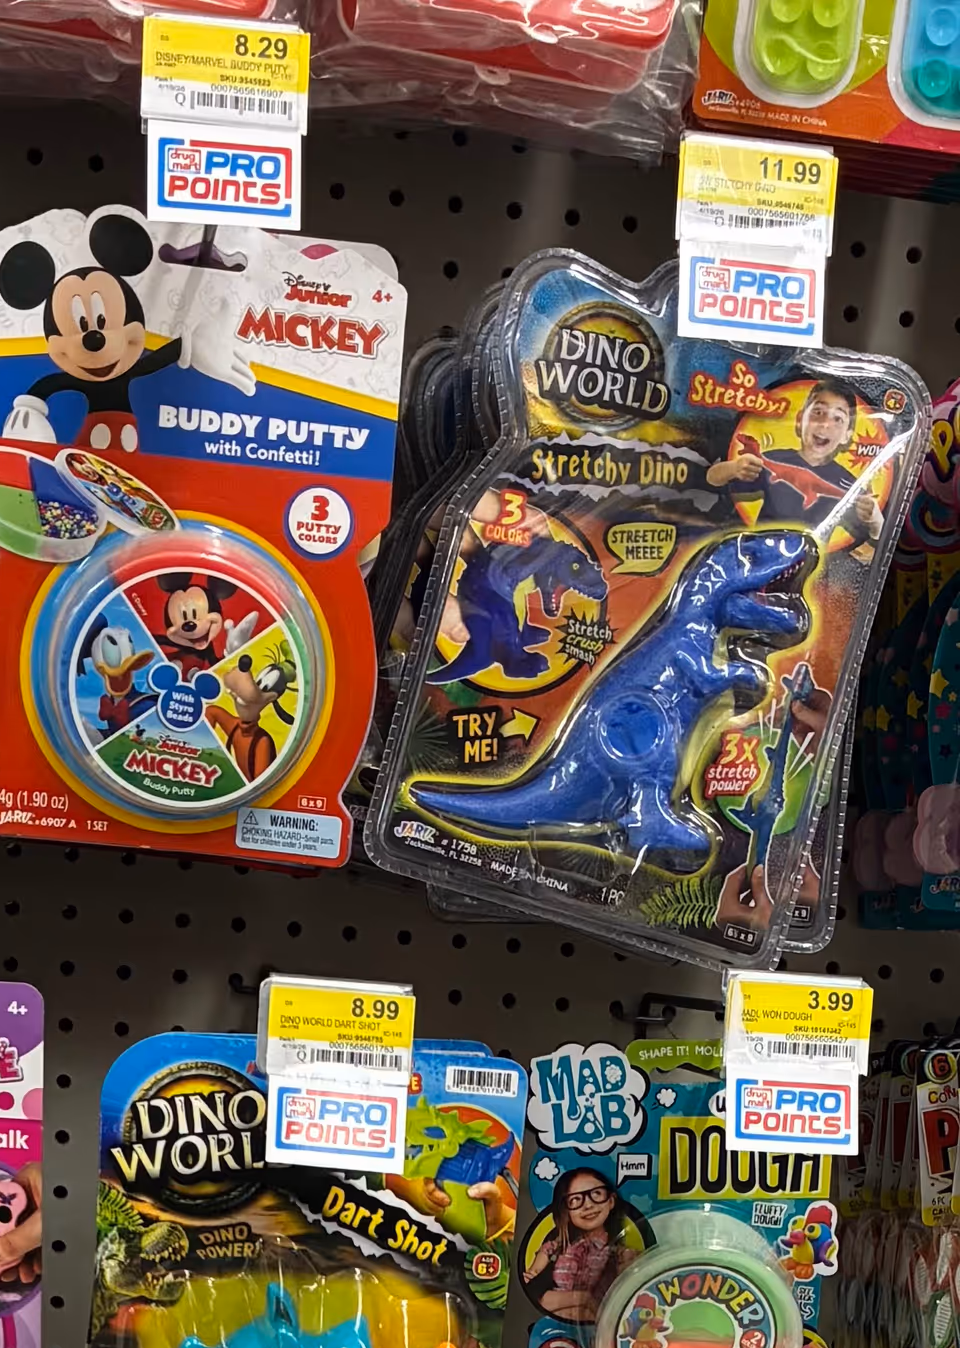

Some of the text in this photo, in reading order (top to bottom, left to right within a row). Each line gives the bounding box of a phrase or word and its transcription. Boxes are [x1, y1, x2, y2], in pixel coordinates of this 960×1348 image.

[235, 34, 288, 60] 8.29
[204, 150, 281, 180] PRO
[759, 157, 821, 185] 11.99
[168, 175, 281, 205] POINTS
[732, 270, 805, 300] PRO
[698, 293, 805, 323] POINTS
[237, 308, 389, 356] MICKEY
[560, 328, 650, 373] DINO
[537, 360, 669, 413] WORLD
[732, 362, 757, 384] So
[690, 376, 789, 415] Stretchy!
[159, 405, 370, 450] BUDDY PUTTY
[205, 439, 321, 467] with Confetti!
[531, 448, 689, 486] Stretchy Dino
[311, 495, 329, 521] 3
[297, 521, 342, 535] PUTTY
[298, 533, 339, 546] COLORS
[453, 712, 497, 736] TRY
[463, 737, 499, 762] ME!
[16, 789, 47, 810] (1.90
[50, 793, 68, 811] oz)
[270, 814, 318, 832] WARNING:
[351, 997, 400, 1020] 8.99
[808, 990, 855, 1012] 3.99
[536, 1055, 629, 1105] MAD
[138, 1089, 265, 1139] DINO
[318, 1102, 387, 1125] PRO
[775, 1090, 841, 1113] PRO
[552, 1095, 631, 1144] LAB
[744, 1111, 841, 1135] POINTS
[284, 1121, 386, 1148] POINTS
[199, 1227, 250, 1246] DINO
[323, 1185, 450, 1266] Dart Shot
[658, 1271, 766, 1327] WONDER
